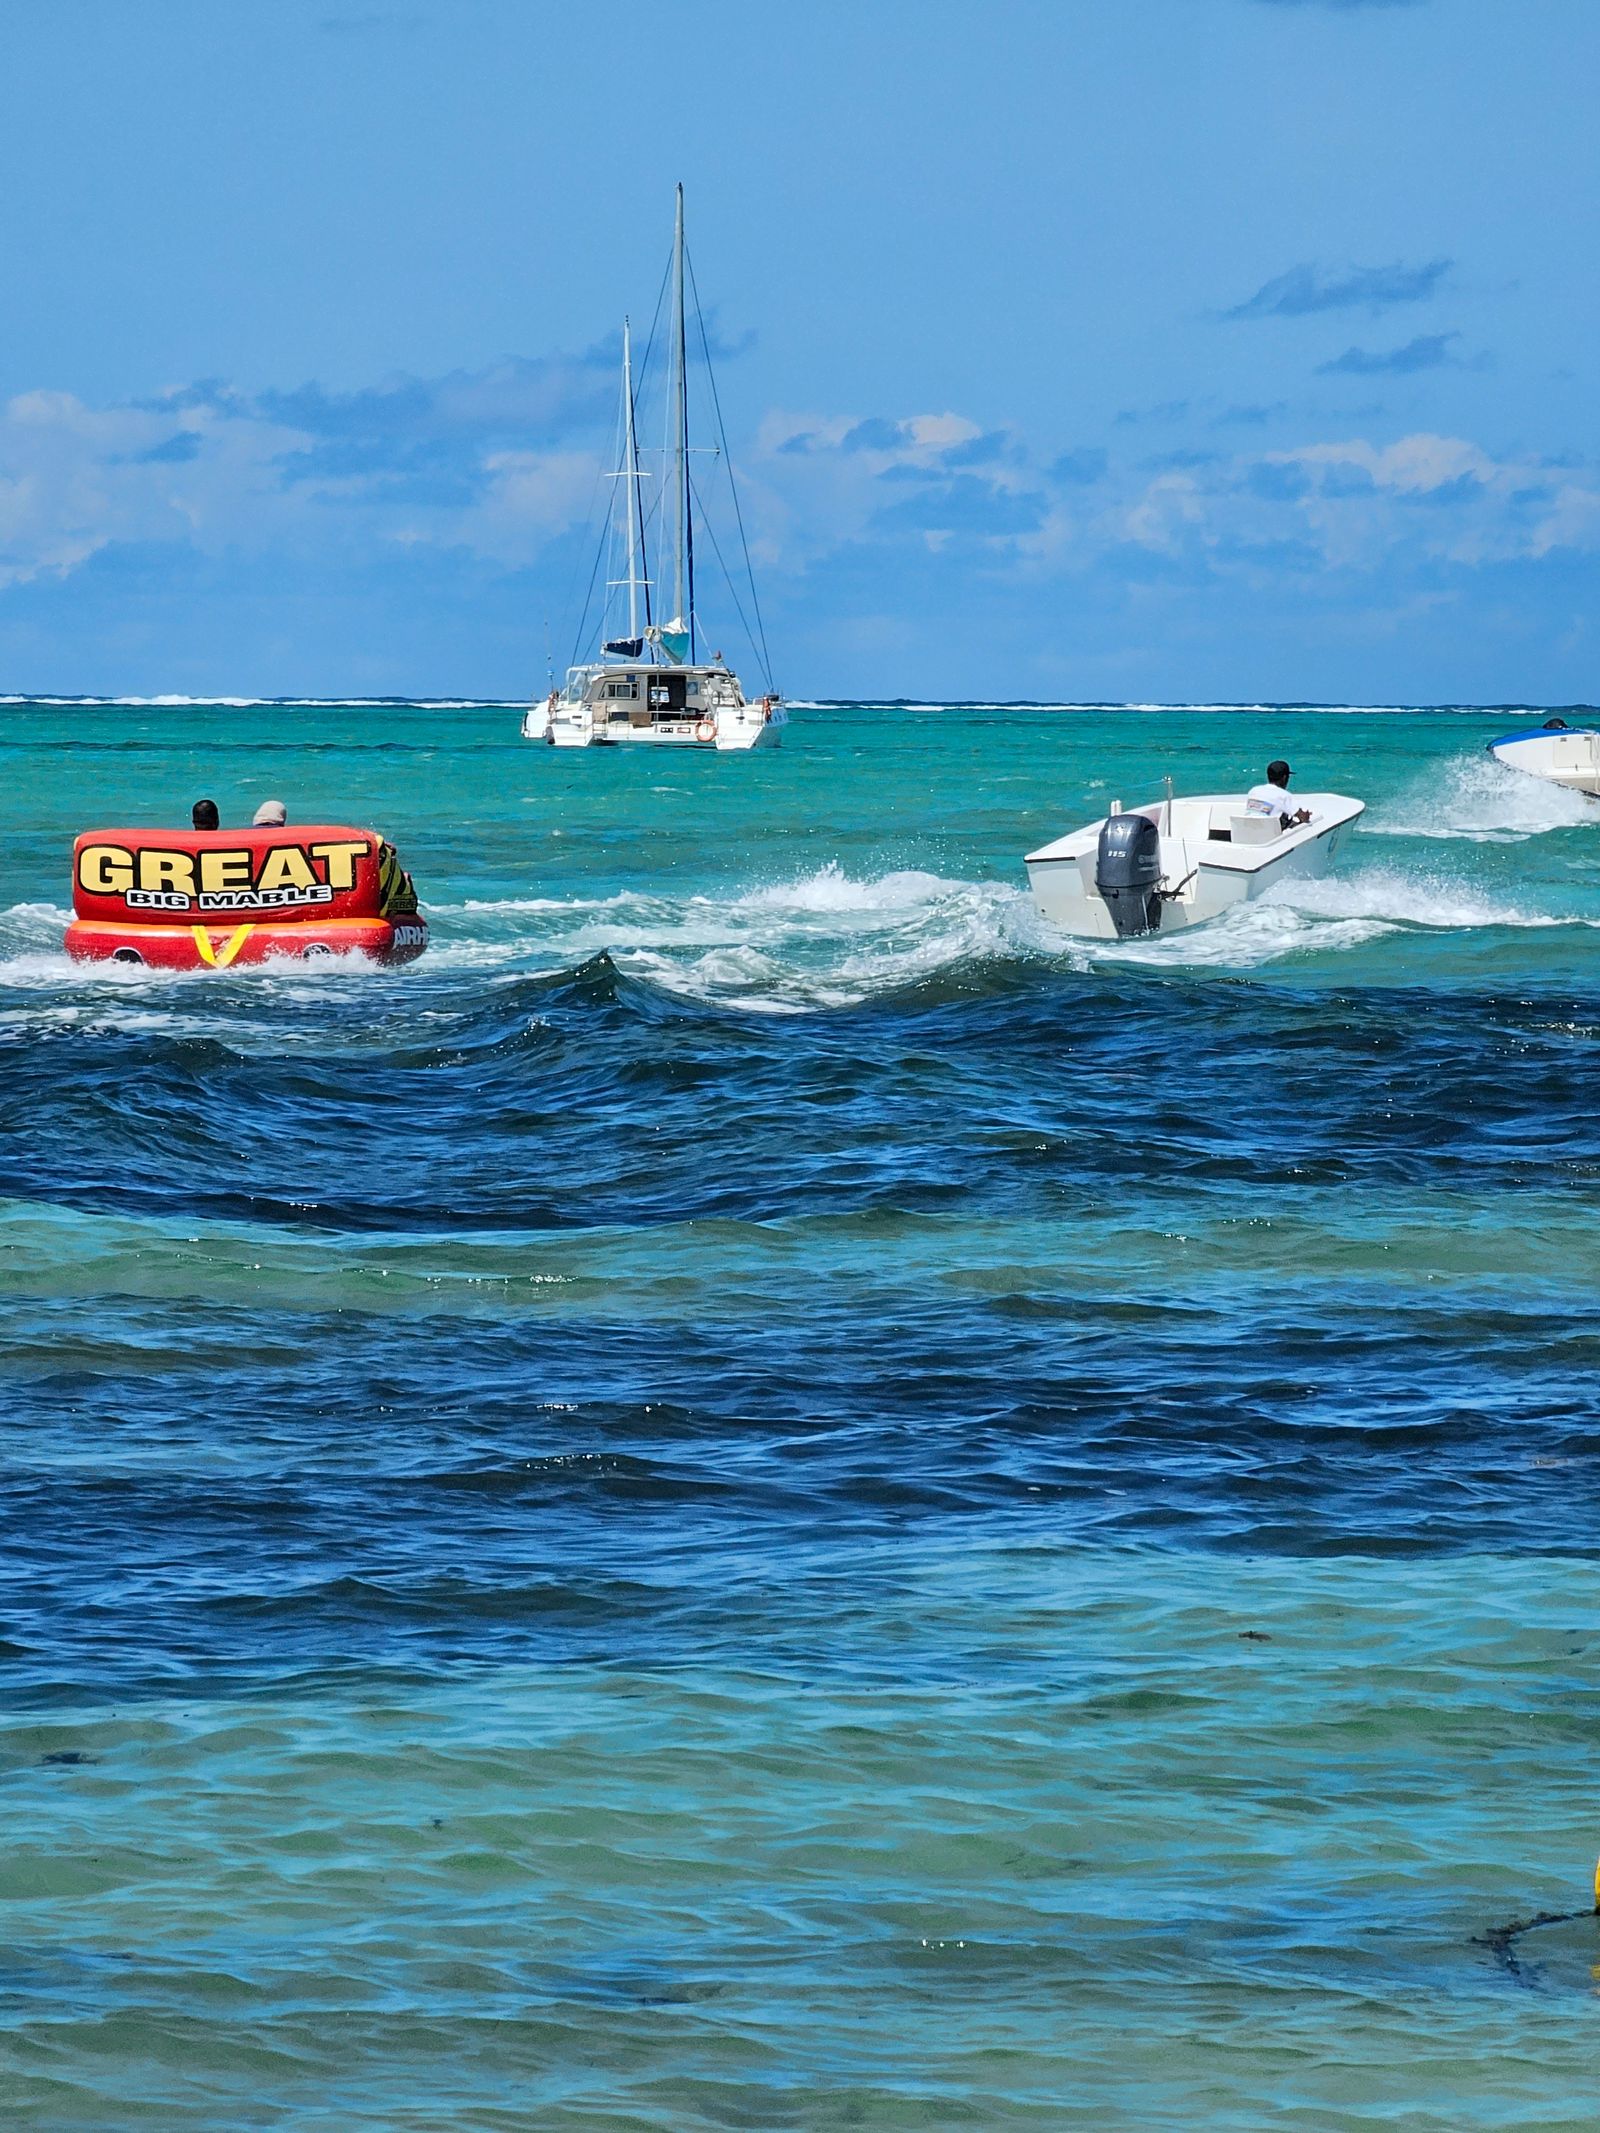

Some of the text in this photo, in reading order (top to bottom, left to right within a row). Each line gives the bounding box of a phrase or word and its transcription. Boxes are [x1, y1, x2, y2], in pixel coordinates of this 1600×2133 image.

[1108, 850, 1127, 858] 115
[78, 842, 369, 897] GREAT
[128, 886, 331, 908] BIG MABLE
